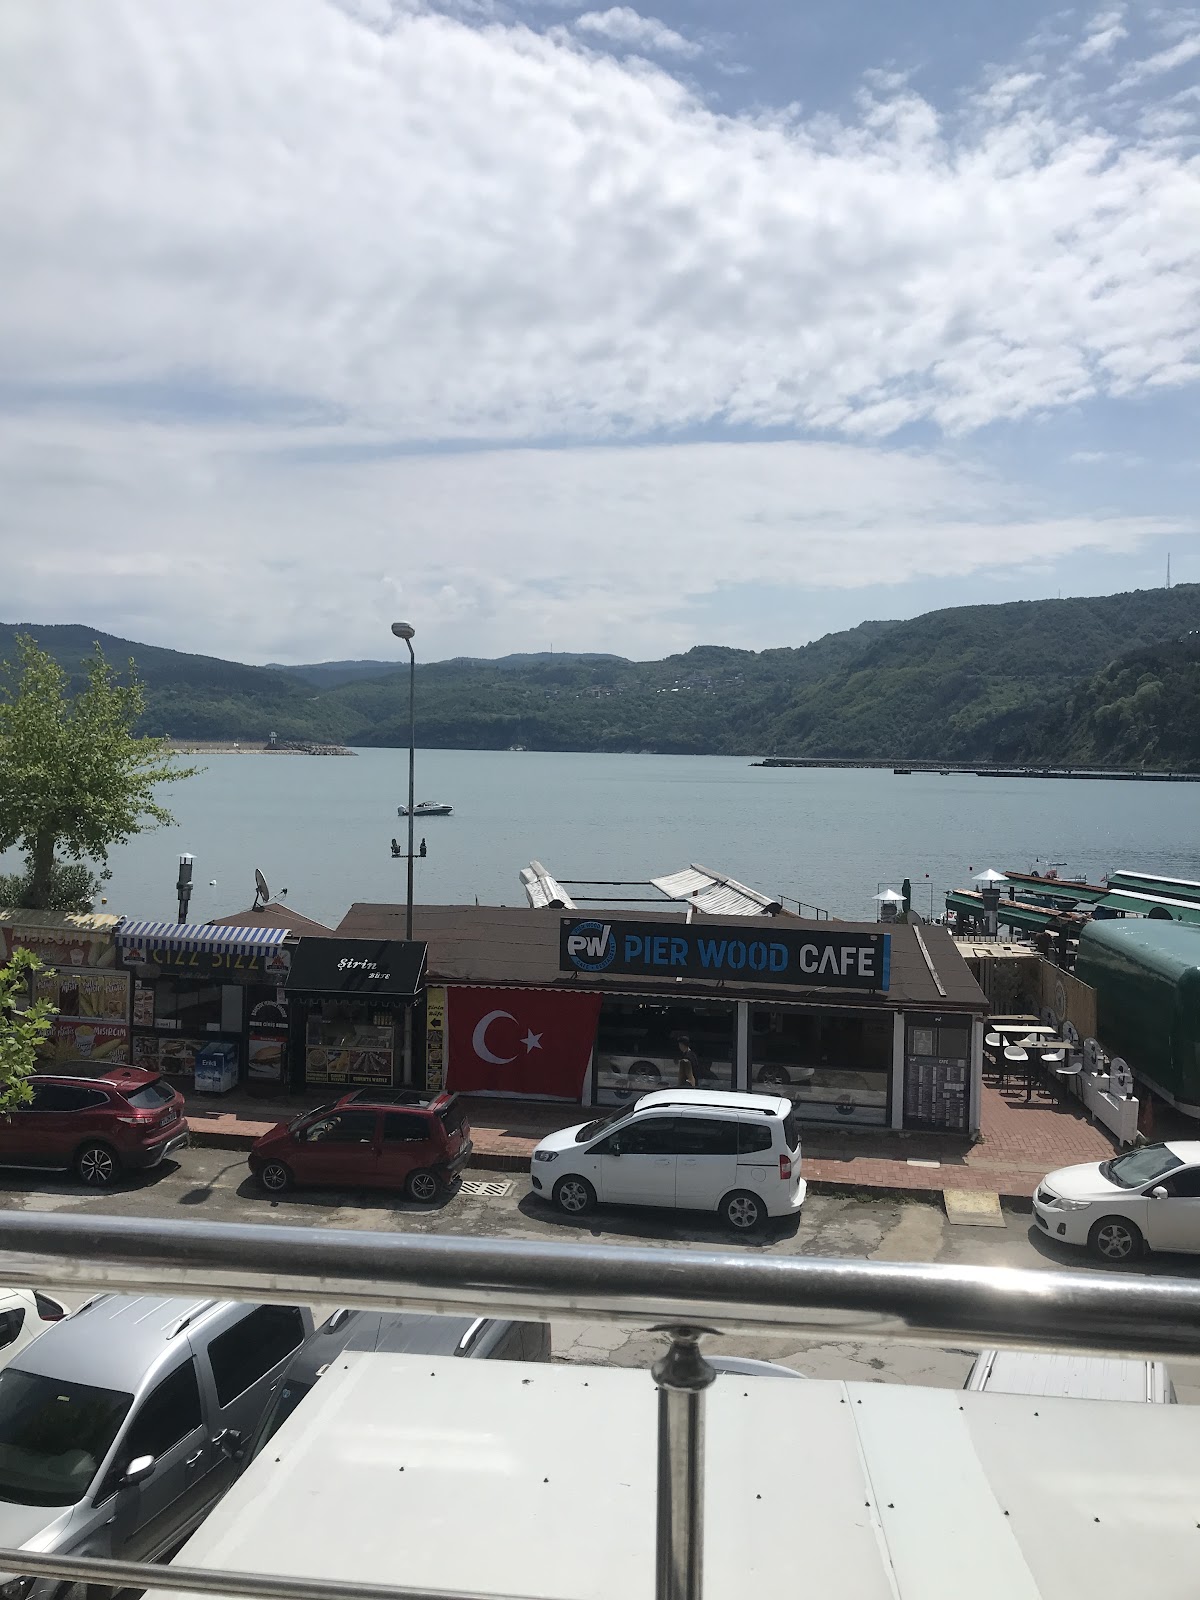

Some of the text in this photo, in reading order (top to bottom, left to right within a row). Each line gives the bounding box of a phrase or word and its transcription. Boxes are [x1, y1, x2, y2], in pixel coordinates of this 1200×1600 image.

[568, 925, 611, 956] PW
[624, 934, 875, 977] PIER WOOD CAFE
[337, 957, 378, 971] Şirin
